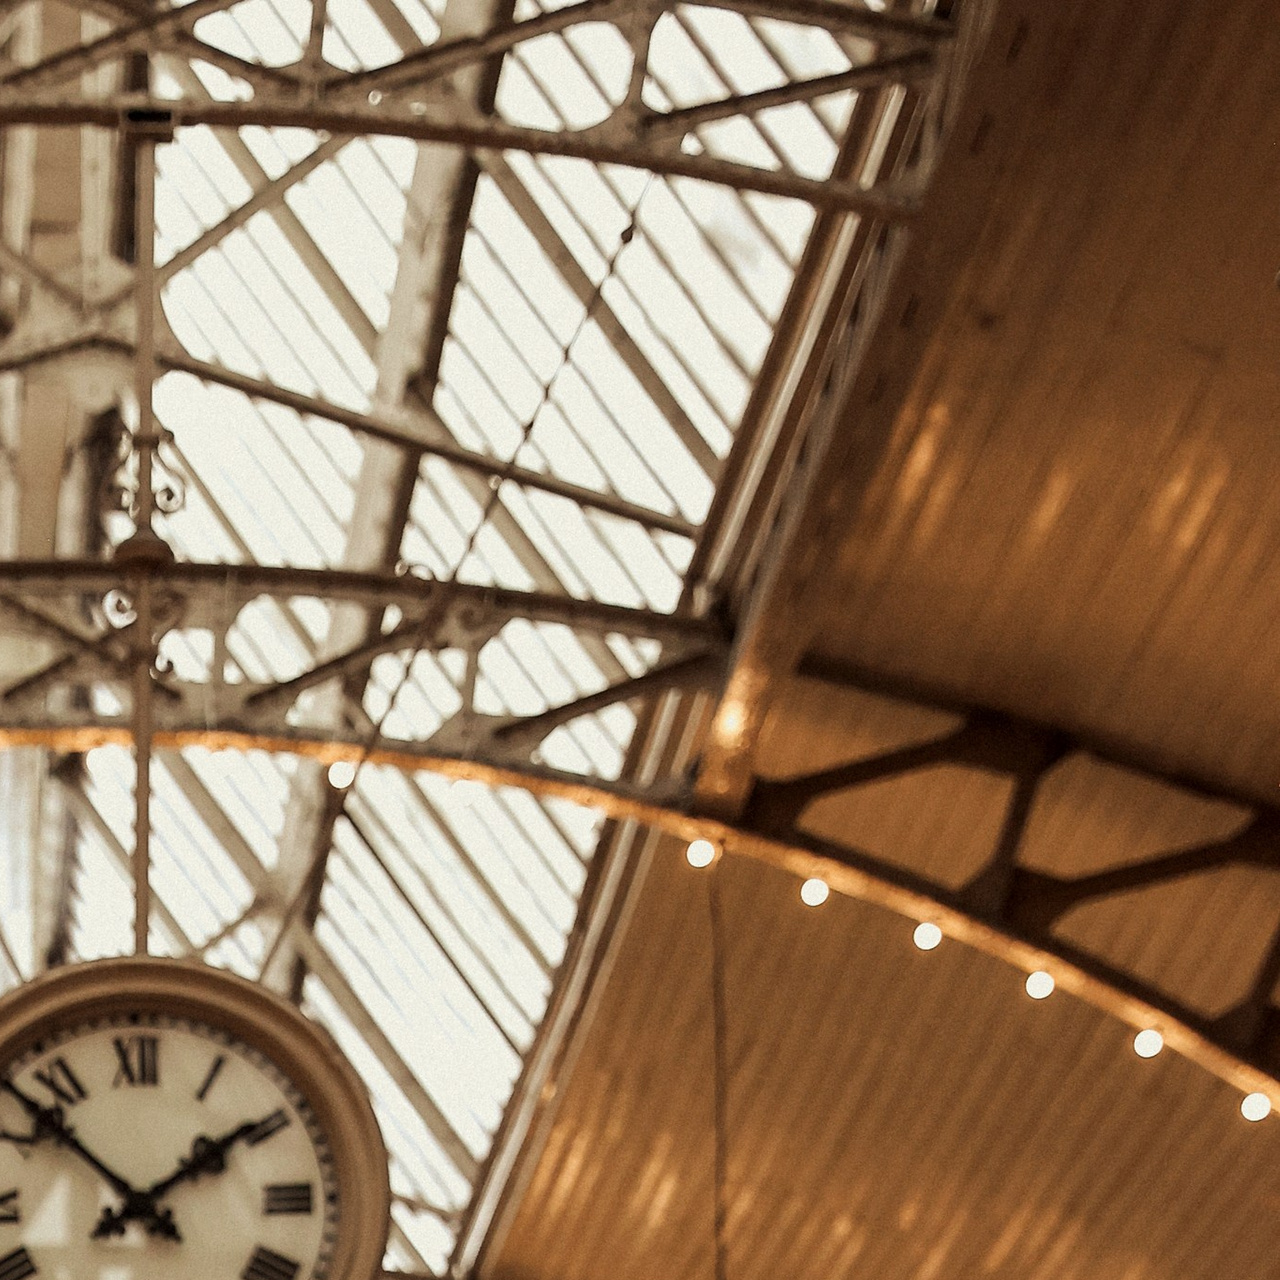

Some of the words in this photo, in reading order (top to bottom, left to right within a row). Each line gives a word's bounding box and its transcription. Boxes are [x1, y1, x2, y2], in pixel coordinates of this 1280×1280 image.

[33, 1055, 88, 1106] XI
[112, 1035, 160, 1089] XII
[196, 1054, 227, 1102] I
[264, 1182, 313, 1216] III
